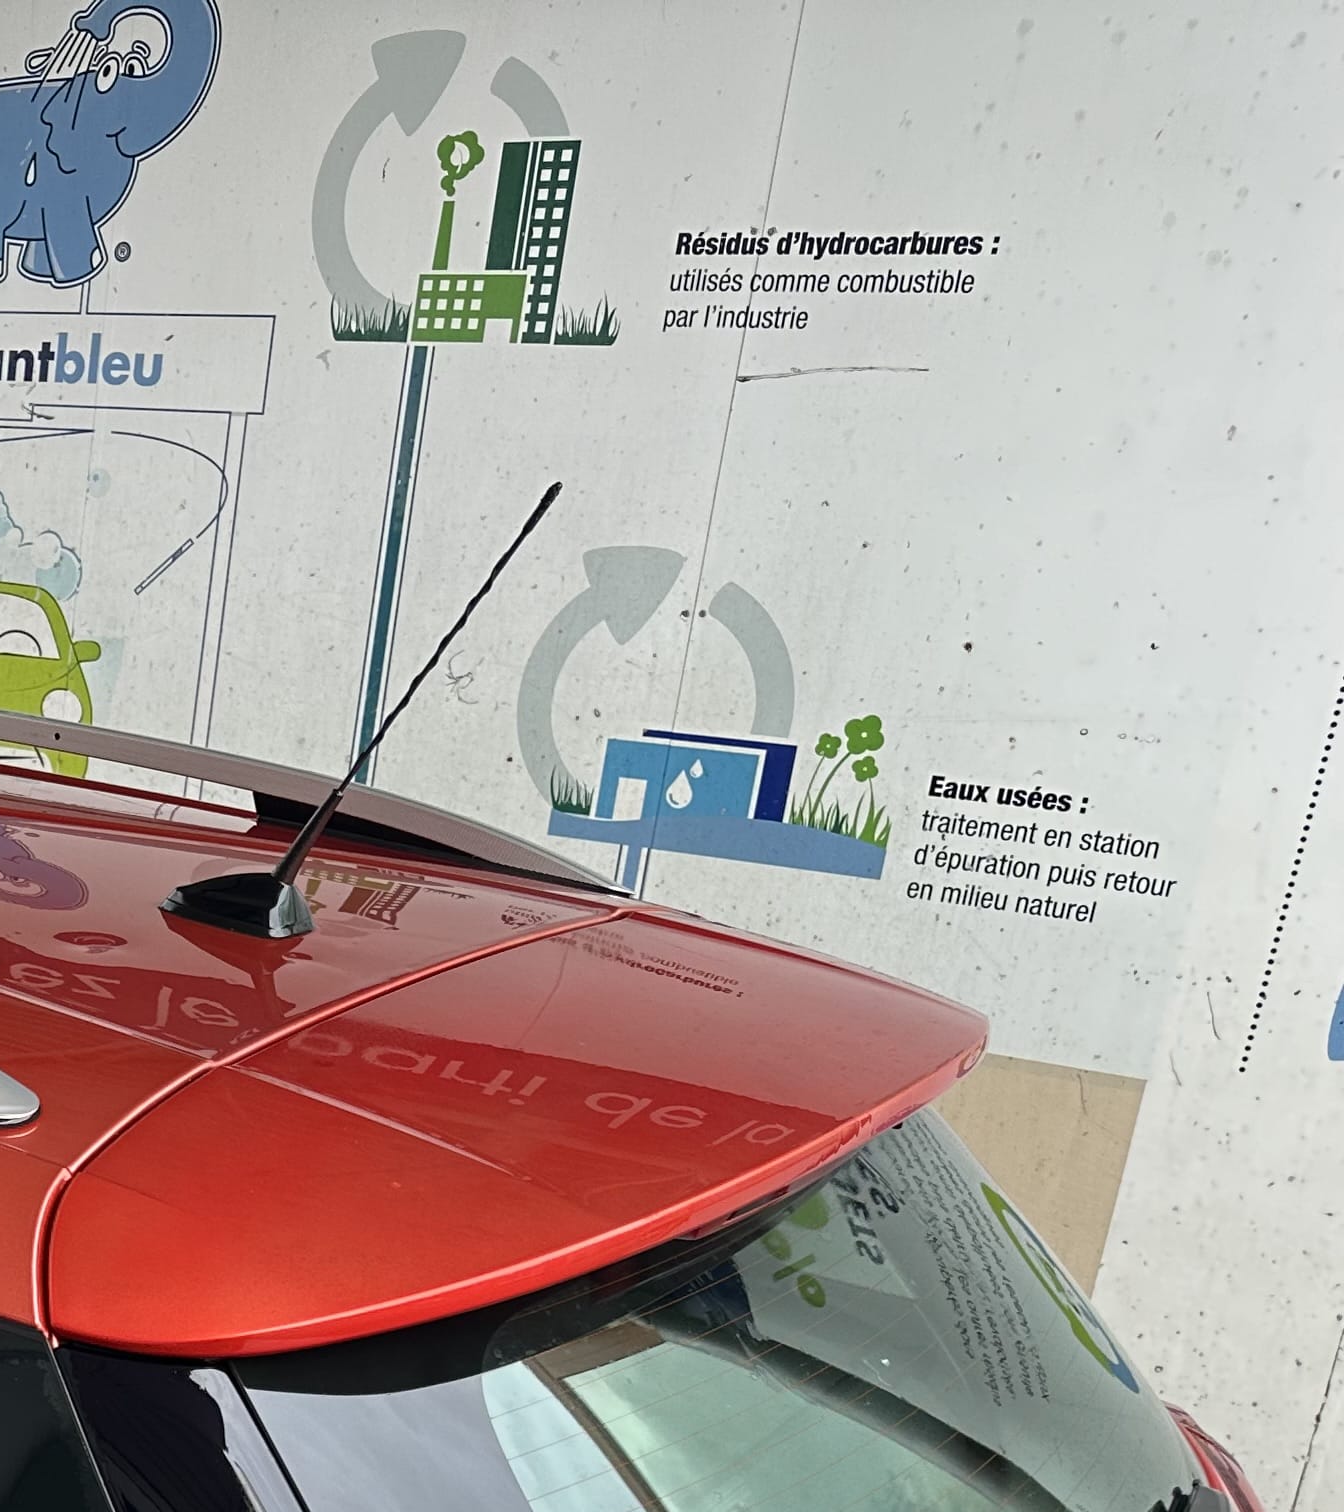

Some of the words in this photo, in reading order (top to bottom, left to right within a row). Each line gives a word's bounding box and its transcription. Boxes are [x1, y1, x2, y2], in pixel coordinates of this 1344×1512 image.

[675, 229, 769, 256] Résidus
[776, 231, 983, 260] d'hydrocarbures
[669, 268, 743, 293] utilisés
[750, 272, 830, 293] comme
[836, 269, 975, 294] combustible
[662, 308, 698, 332] par
[703, 305, 809, 330] l'industrie
[928, 775, 990, 803] Eaux
[996, 786, 1072, 812] usées
[921, 810, 1038, 844] traitement
[1043, 828, 1072, 848] en
[1079, 830, 1160, 859] station
[913, 844, 1041, 880] d'épuration
[1046, 864, 1097, 887] puis
[1103, 872, 1177, 897] retour
[906, 881, 933, 900] en
[940, 885, 1009, 911] milieu
[1015, 895, 1097, 923] naturel
